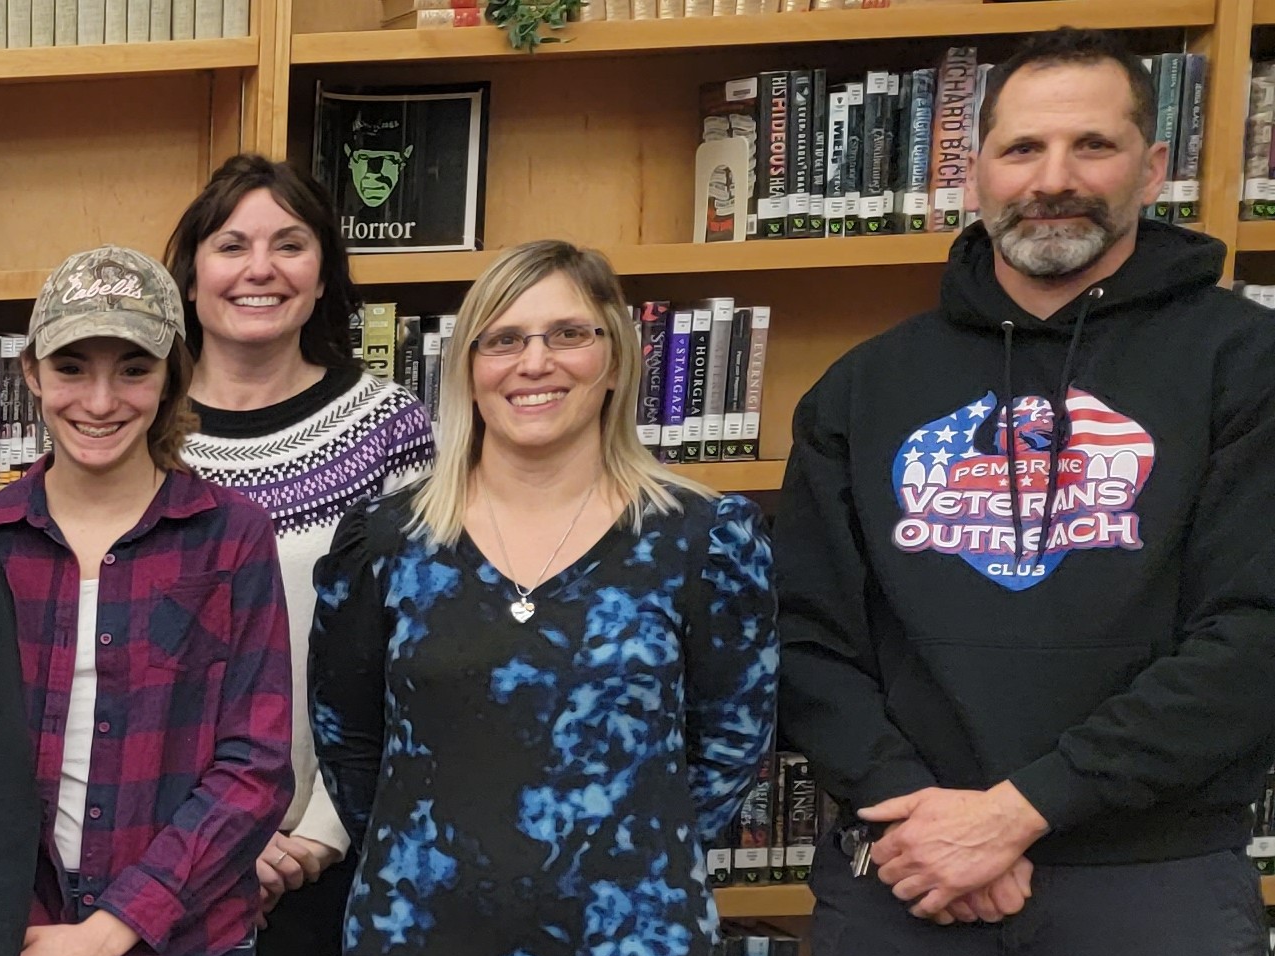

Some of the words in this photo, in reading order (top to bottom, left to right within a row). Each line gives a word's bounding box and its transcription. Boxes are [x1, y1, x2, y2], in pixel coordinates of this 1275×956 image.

[771, 76, 788, 97] HIS
[941, 50, 968, 132] RICHARD
[769, 99, 788, 177] HIDEOUS
[939, 137, 965, 188] BACH
[341, 215, 417, 240] Horror
[367, 344, 389, 378] EC
[647, 331, 666, 392] STRANGE
[690, 345, 707, 415] HOURGLA
[902, 480, 1129, 518] VETERANS
[895, 512, 1137, 554] OUTREACH
[987, 563, 1045, 577] CLUB
[792, 779, 807, 822] KING
